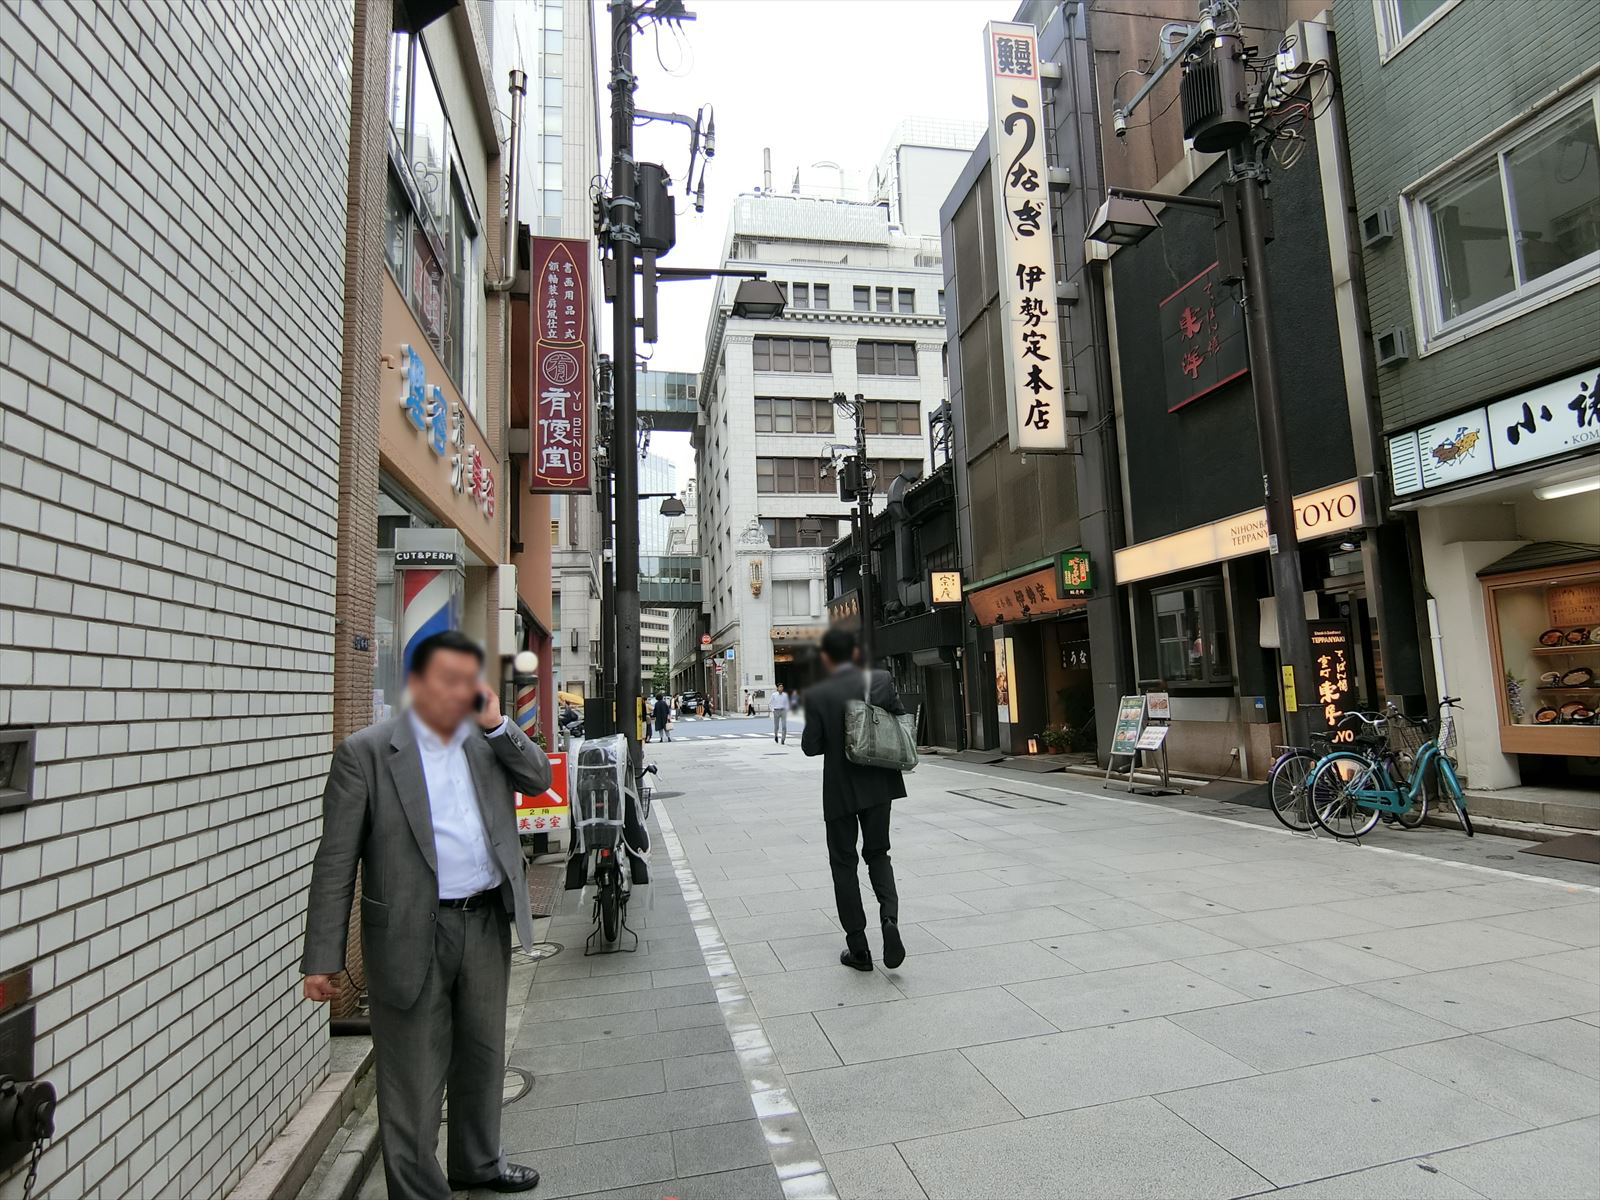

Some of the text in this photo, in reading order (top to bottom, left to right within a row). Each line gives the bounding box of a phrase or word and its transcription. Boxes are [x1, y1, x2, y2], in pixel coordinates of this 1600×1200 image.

[1000, 94, 1045, 240] うなぎ
[562, 262, 576, 340] 書画用品一式
[1016, 264, 1055, 430] 伊勢定本店
[396, 552, 454, 562] CUT&PERM
[1331, 729, 1355, 744] YO
[519, 816, 561, 831] 美容室
